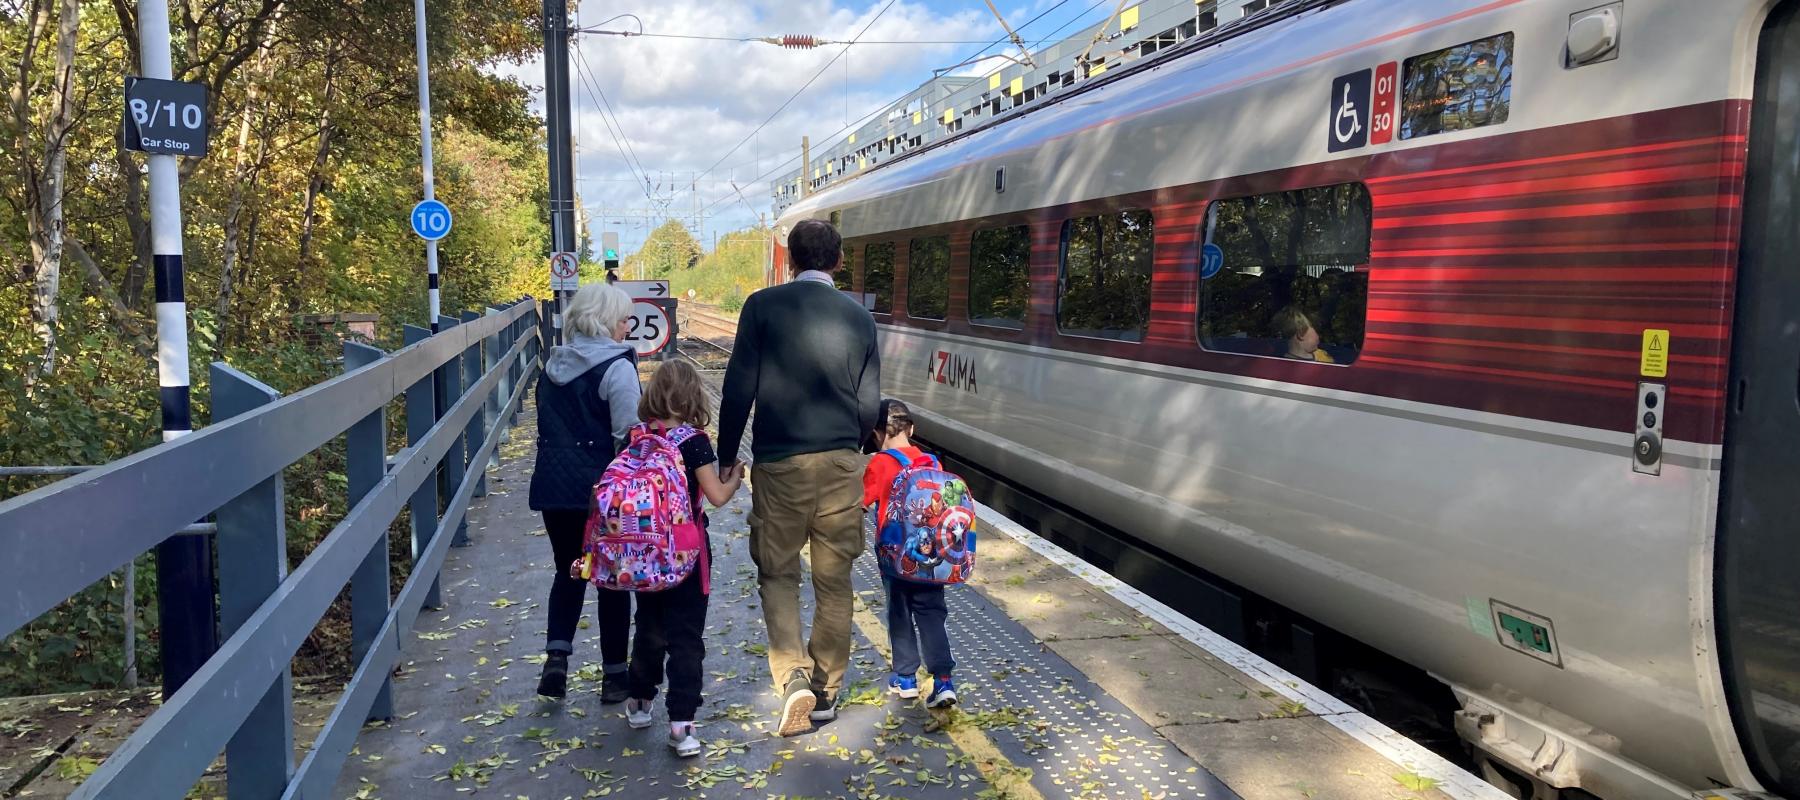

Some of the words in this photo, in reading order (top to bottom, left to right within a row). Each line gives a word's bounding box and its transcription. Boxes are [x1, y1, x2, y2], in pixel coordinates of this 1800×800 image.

[1378, 75, 1393, 95] 01
[129, 98, 202, 129] 8/10
[1373, 112, 1391, 132] 30
[142, 137, 161, 147] Car
[164, 139, 190, 151] Stop
[417, 212, 446, 232] 10
[625, 315, 660, 340] 25
[927, 351, 978, 394] AZUMA
